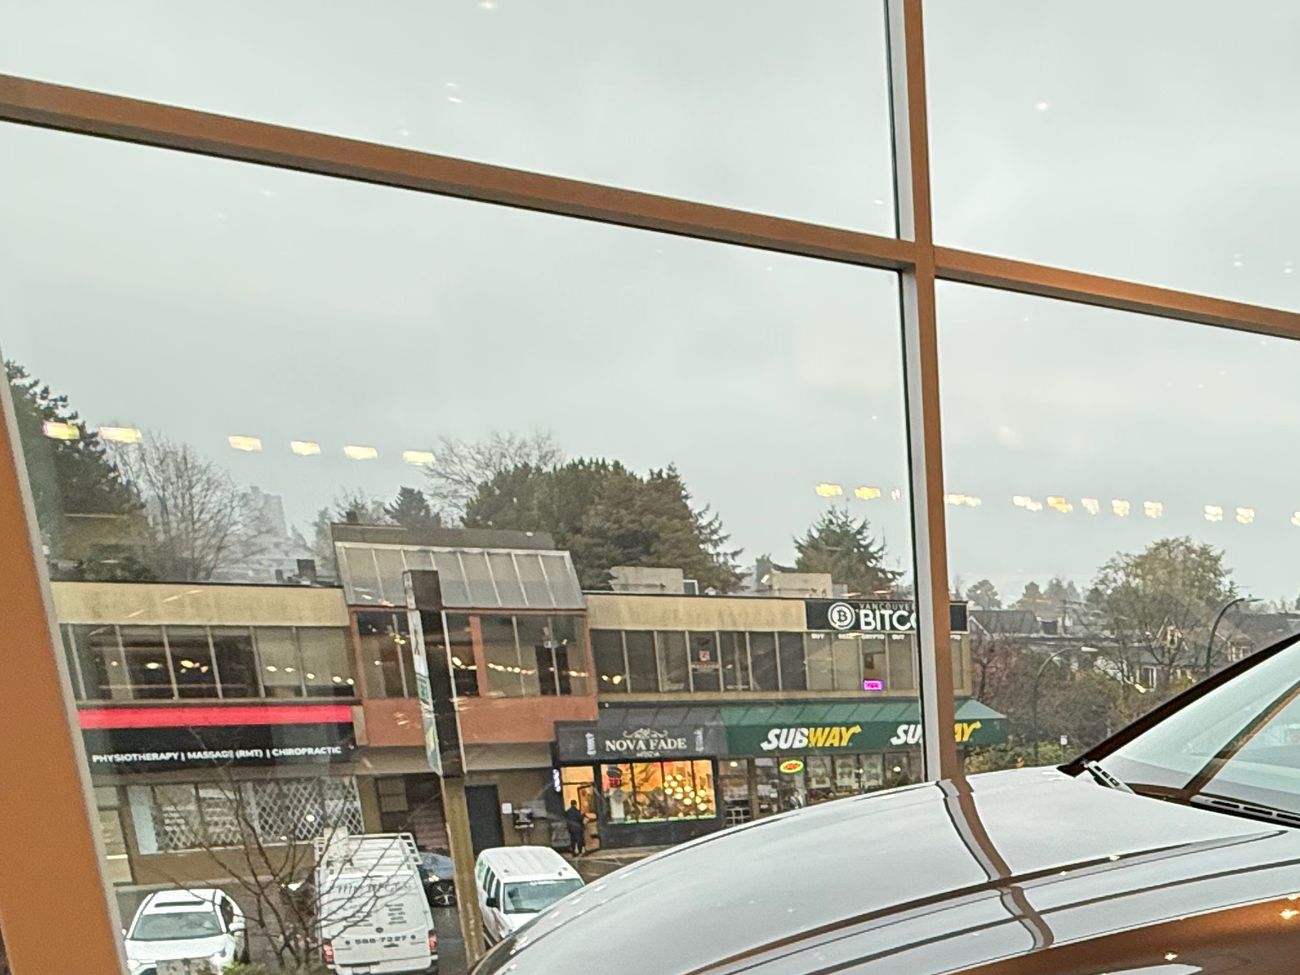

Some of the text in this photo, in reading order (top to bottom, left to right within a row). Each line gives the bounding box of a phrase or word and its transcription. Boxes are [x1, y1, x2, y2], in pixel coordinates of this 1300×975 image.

[859, 601, 915, 611] VANCOUVE
[605, 739, 647, 752] NOVA
[649, 737, 688, 750] FADE
[760, 724, 862, 751] SUBWAY
[92, 751, 179, 763] PHYSIOTHERAPY
[271, 746, 342, 757] CHIROPRACTIC
